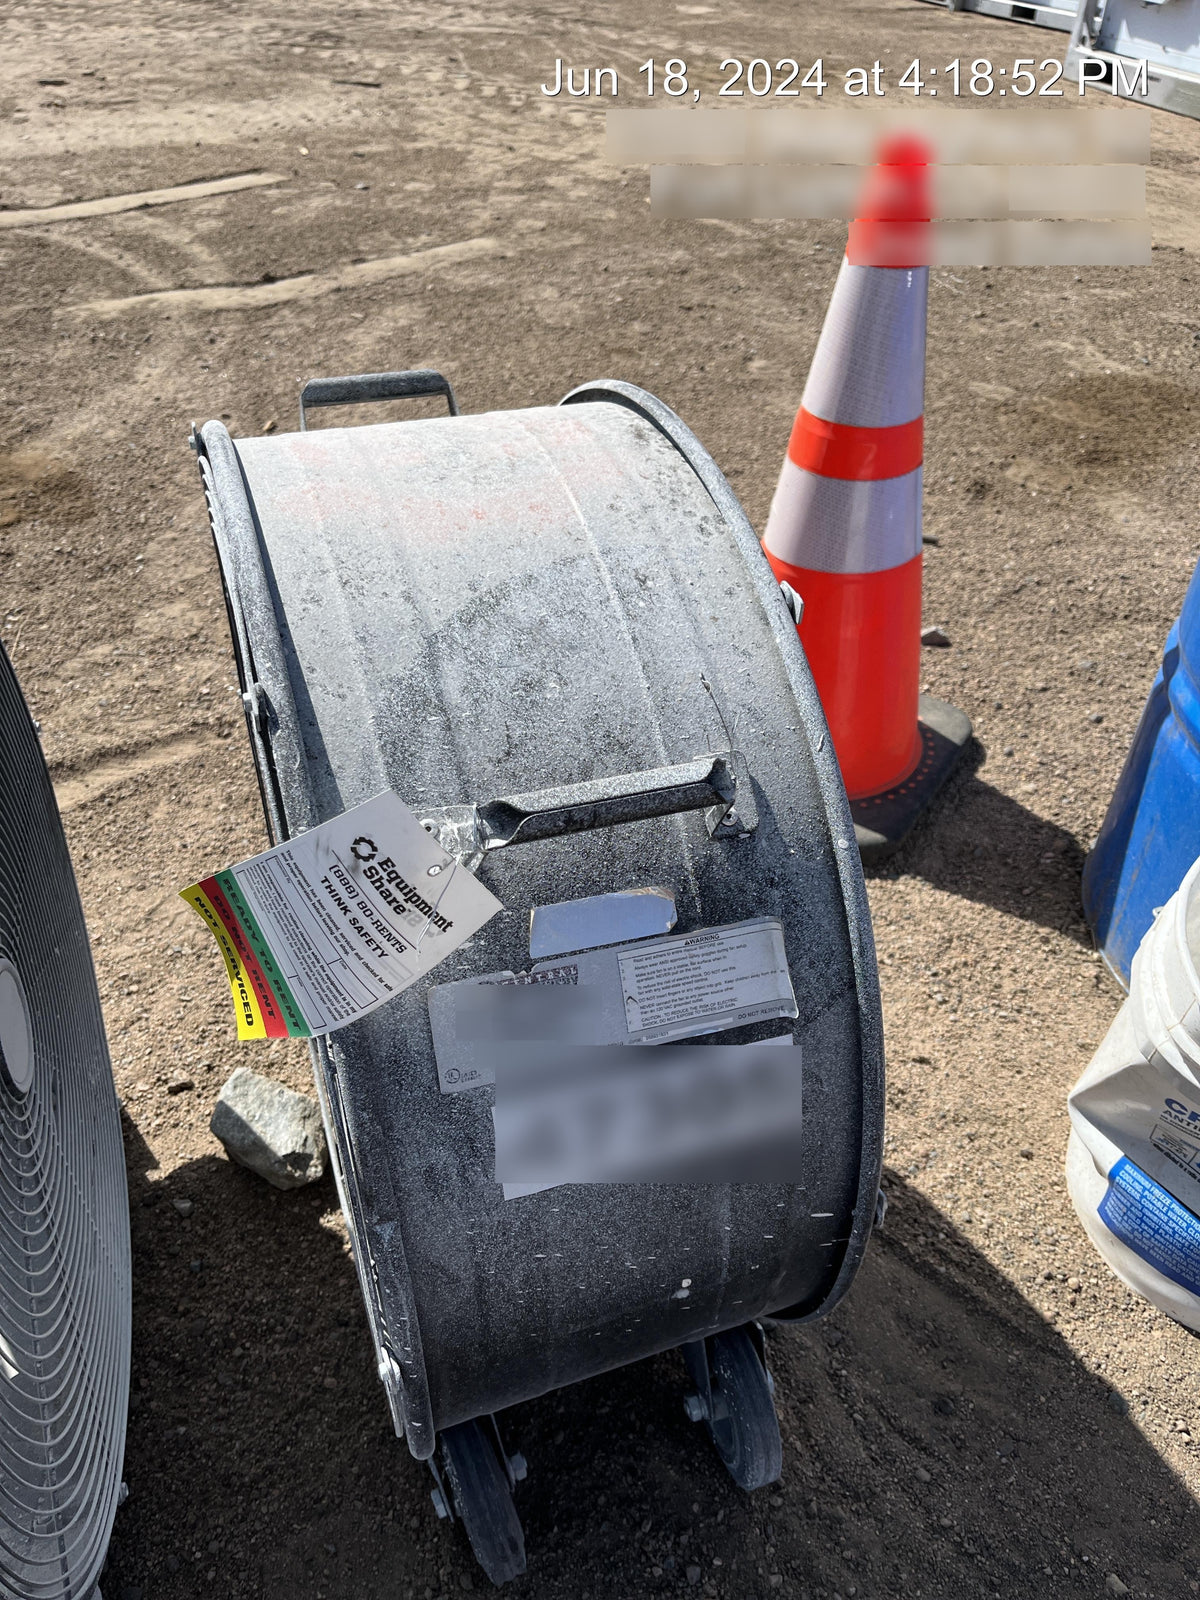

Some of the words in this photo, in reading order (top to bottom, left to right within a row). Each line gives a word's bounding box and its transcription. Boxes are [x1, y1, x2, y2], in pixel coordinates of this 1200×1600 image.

[320, 876, 352, 916] THINK
[348, 916, 389, 958] SAFETY
[327, 863, 360, 900] (888)
[356, 900, 407, 955] 80-RENTS
[362, 865, 408, 916] Share
[377, 857, 453, 933] Equipment
[194, 897, 220, 929] NOT
[219, 936, 255, 1027] SERVICED
[213, 894, 231, 922] DO
[230, 926, 253, 964] NOT
[251, 970, 277, 1019] RENT
[222, 877, 261, 944] READY
[258, 949, 275, 974] TO
[273, 979, 302, 1030] RENT
[690, 933, 720, 944] WARNING
[1140, 1198, 1169, 1223] CONTAINS
[1143, 1190, 1168, 1213] POTABLE
[1166, 1210, 1188, 1231] WATER,
[1150, 1186, 1172, 1207] FREEZE
